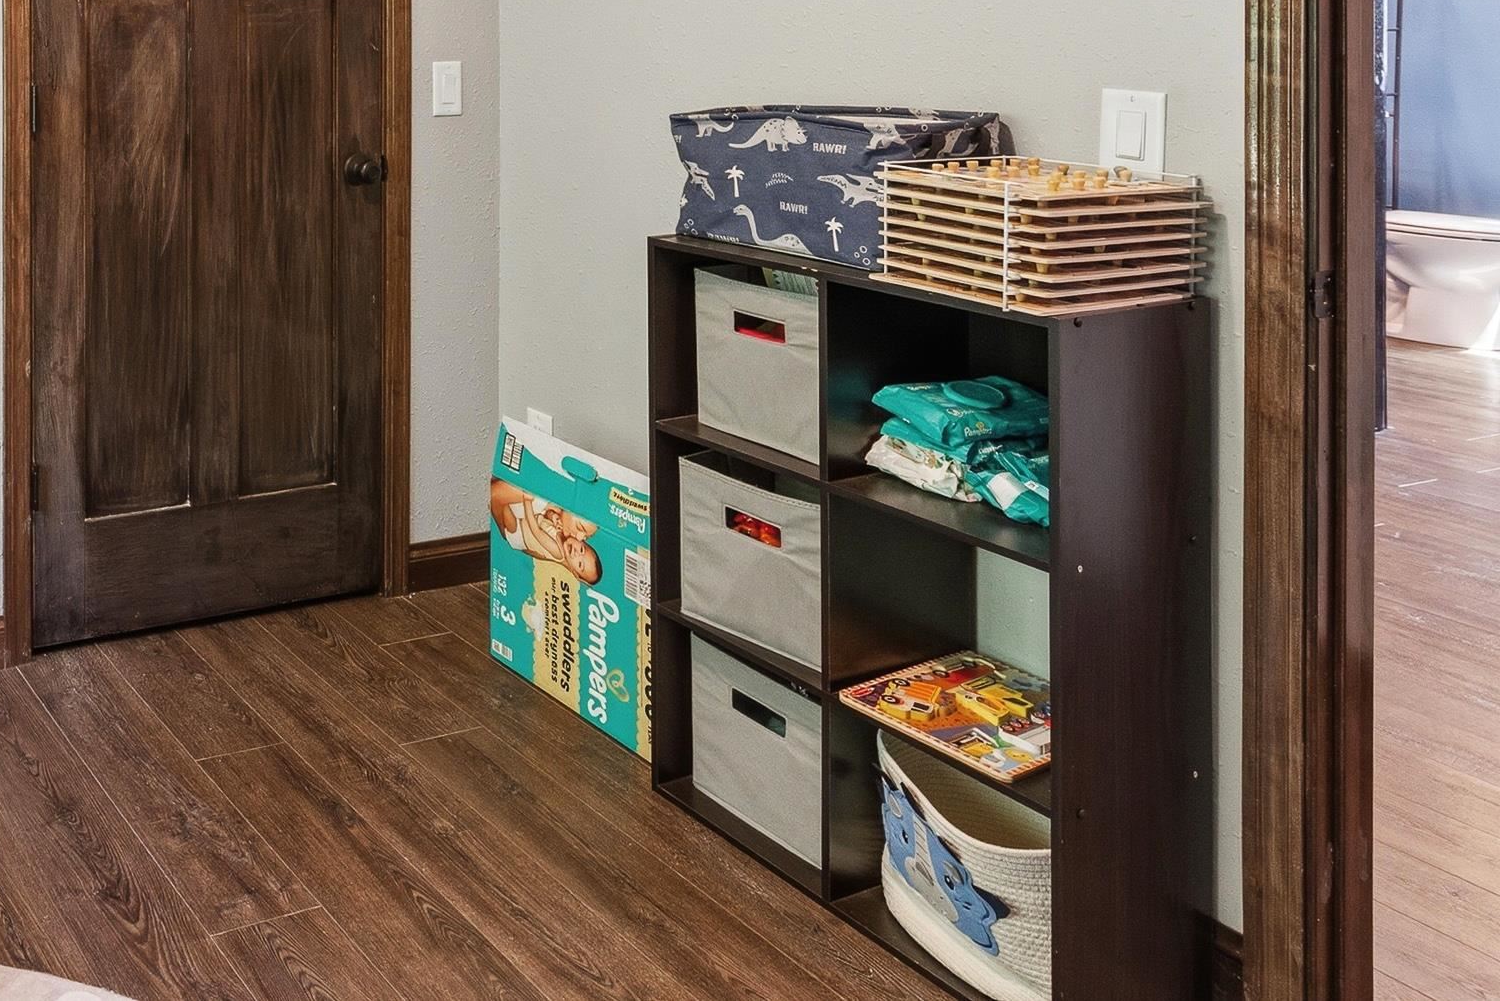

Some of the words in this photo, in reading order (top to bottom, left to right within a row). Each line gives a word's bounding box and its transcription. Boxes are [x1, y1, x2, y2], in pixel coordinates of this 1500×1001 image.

[812, 142, 847, 155] RAWR!
[779, 201, 808, 214] RAWR!
[500, 605, 516, 626] 3
[551, 594, 560, 625] best
[560, 580, 575, 693] swaddlers
[550, 627, 560, 683] dryness
[583, 588, 619, 724] Pampers
